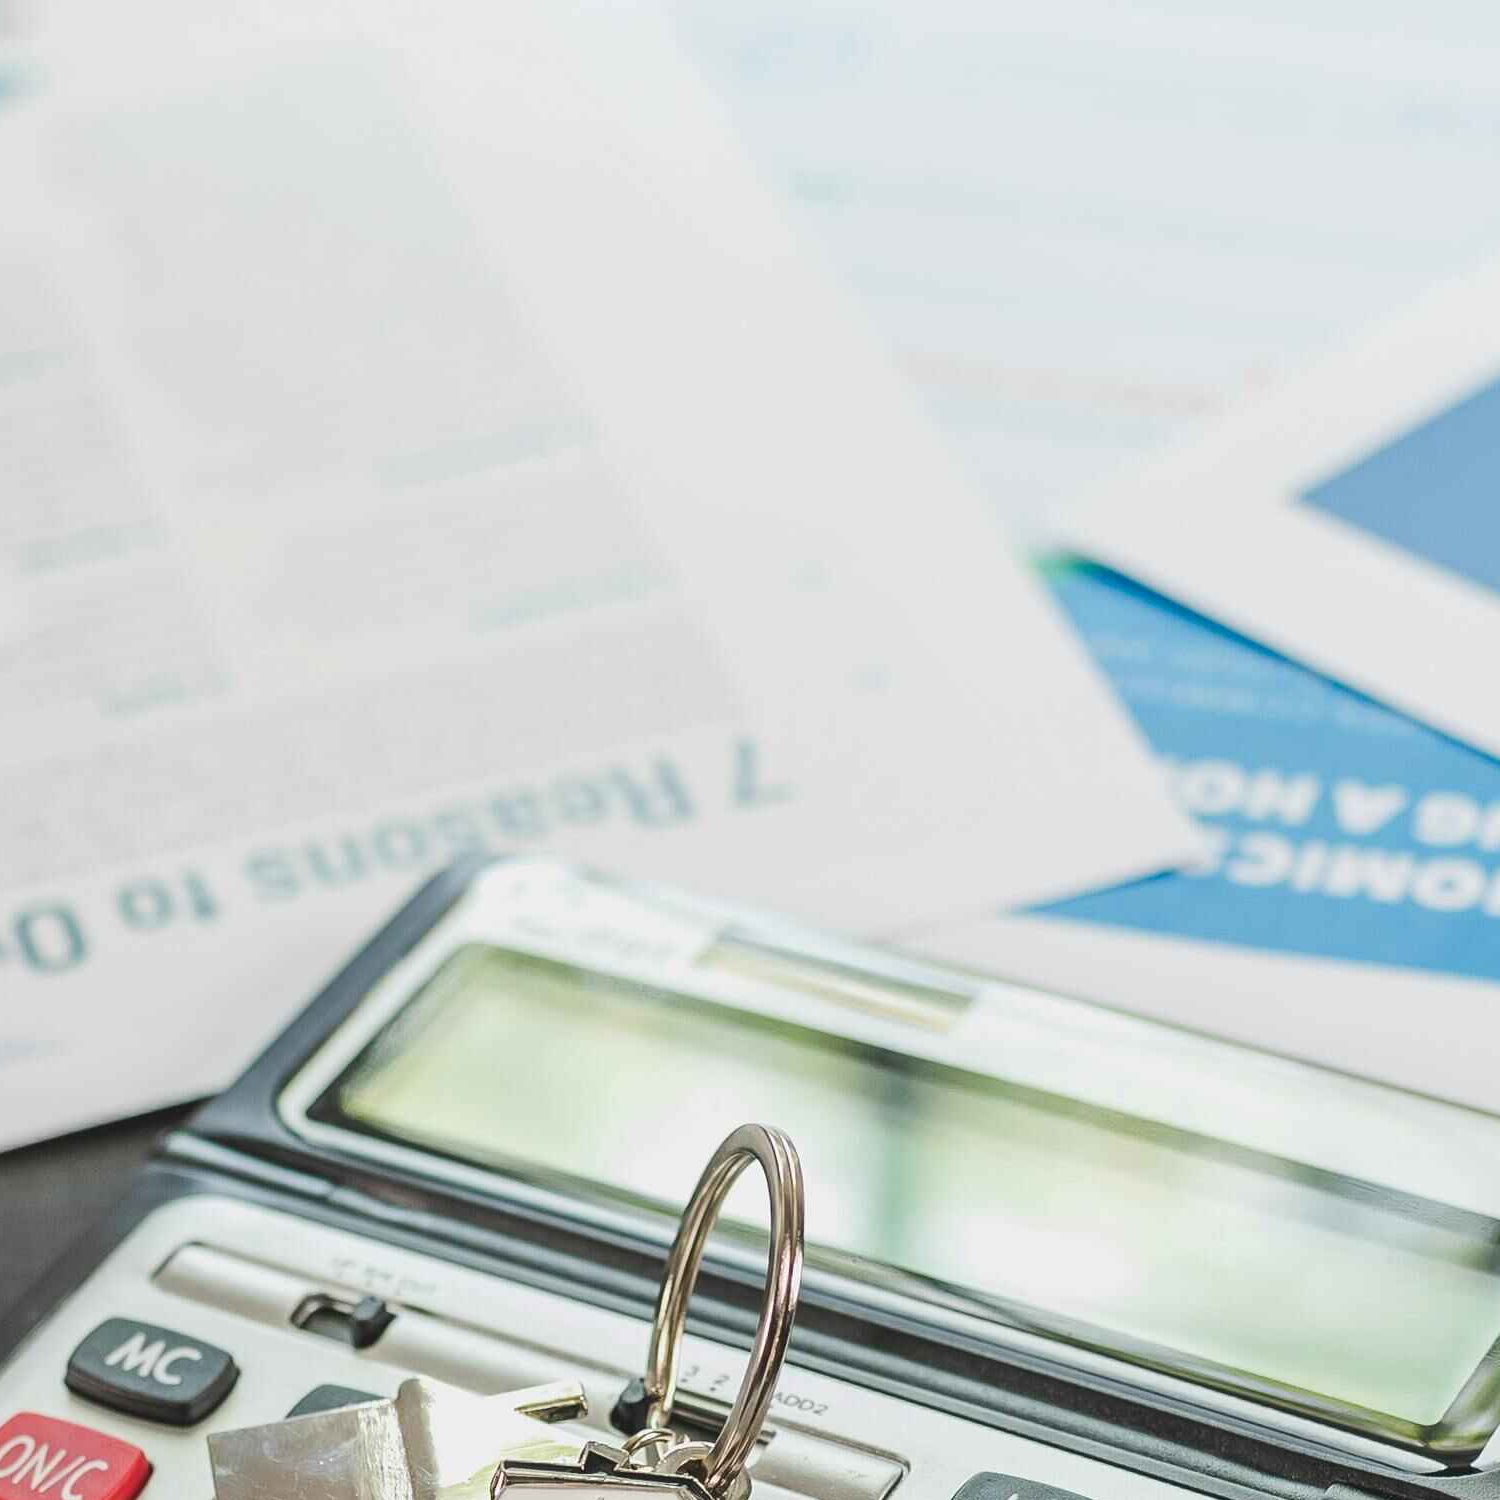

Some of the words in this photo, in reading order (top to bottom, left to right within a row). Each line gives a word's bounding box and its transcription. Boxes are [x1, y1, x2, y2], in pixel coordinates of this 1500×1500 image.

[246, 756, 693, 908] Reasons
[115, 868, 217, 937] to
[104, 1332, 203, 1386] MC
